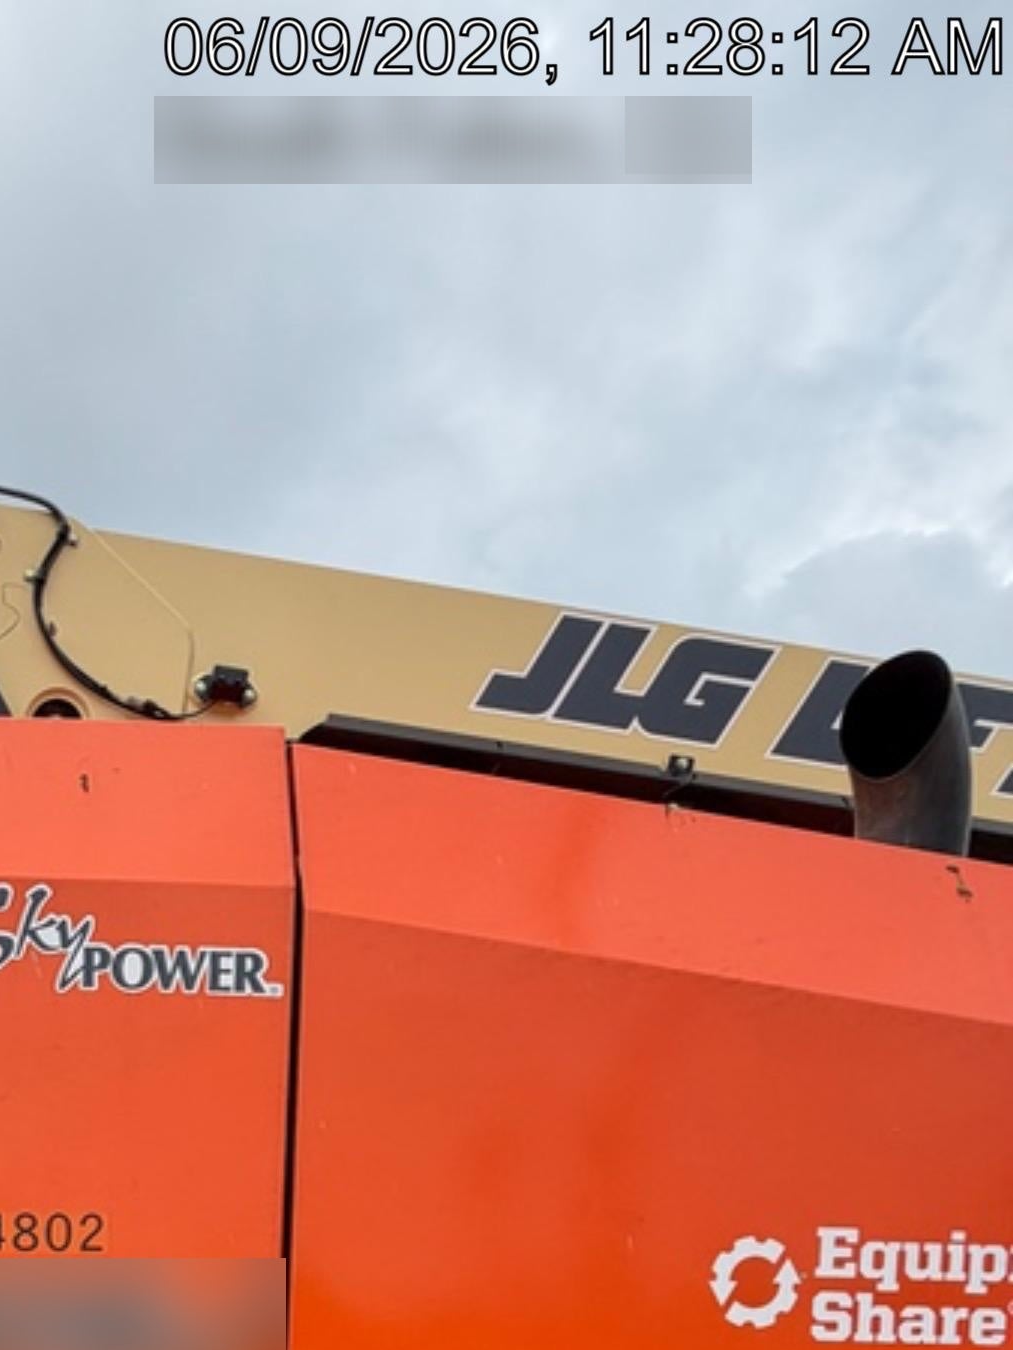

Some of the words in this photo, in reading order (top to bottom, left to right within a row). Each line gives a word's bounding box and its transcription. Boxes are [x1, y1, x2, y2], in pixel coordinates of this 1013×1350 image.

[469, 609, 782, 748] JLG
[814, 1226, 1013, 1294] Equip
[810, 1289, 1008, 1346] Share
